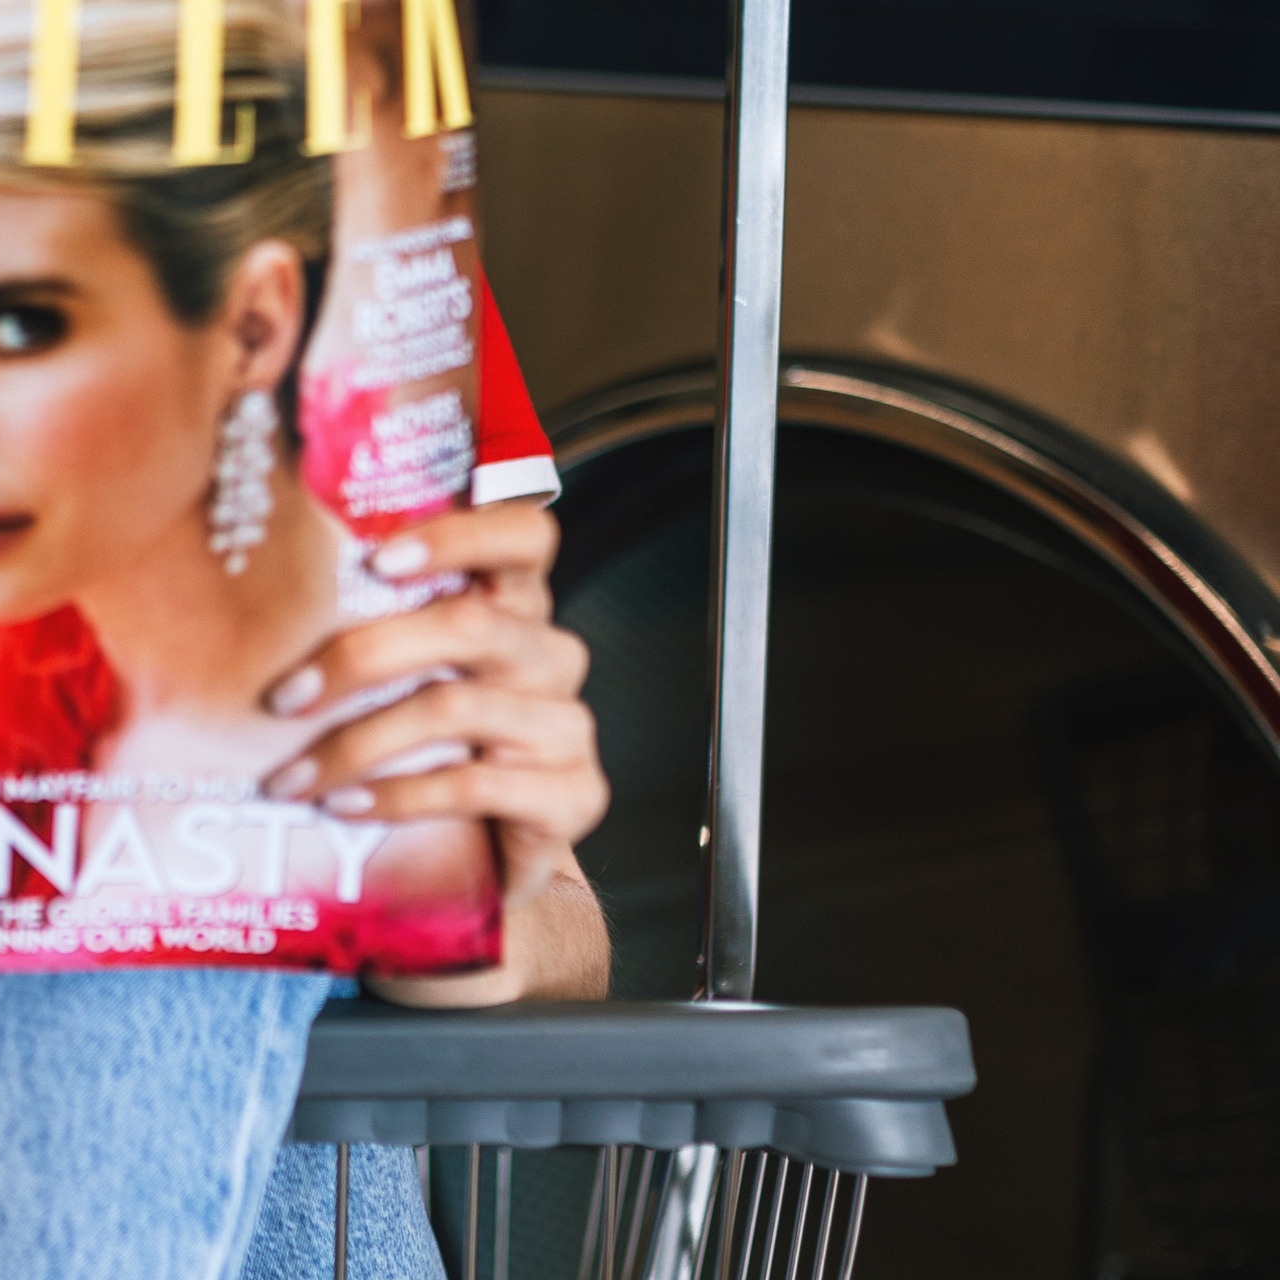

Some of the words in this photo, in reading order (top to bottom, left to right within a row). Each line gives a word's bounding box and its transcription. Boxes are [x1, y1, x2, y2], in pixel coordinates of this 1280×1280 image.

[180, 900, 318, 932] FAMILIES
[83, 927, 155, 955] OUR
[159, 927, 277, 956] WORLD
